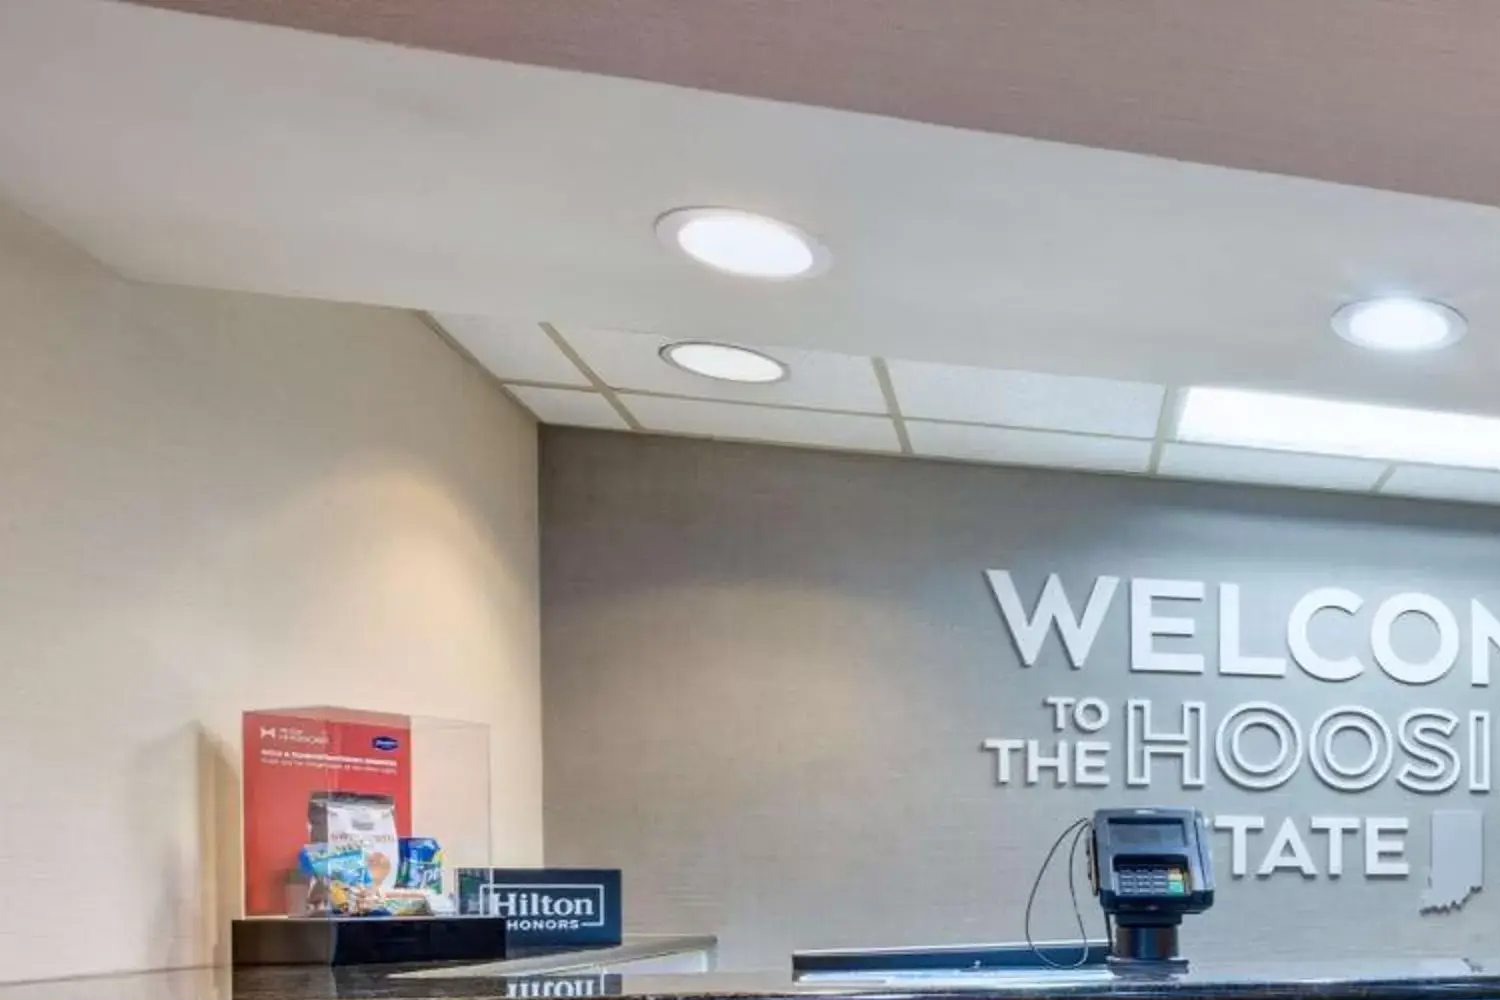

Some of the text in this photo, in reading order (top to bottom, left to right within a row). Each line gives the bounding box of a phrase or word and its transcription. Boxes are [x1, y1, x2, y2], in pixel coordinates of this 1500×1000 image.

[1046, 696, 1109, 731] TO
[984, 738, 1110, 785] THE
[1204, 815, 1409, 876] TATE
[491, 892, 595, 917] Hilton
[506, 919, 580, 931] HONORS
